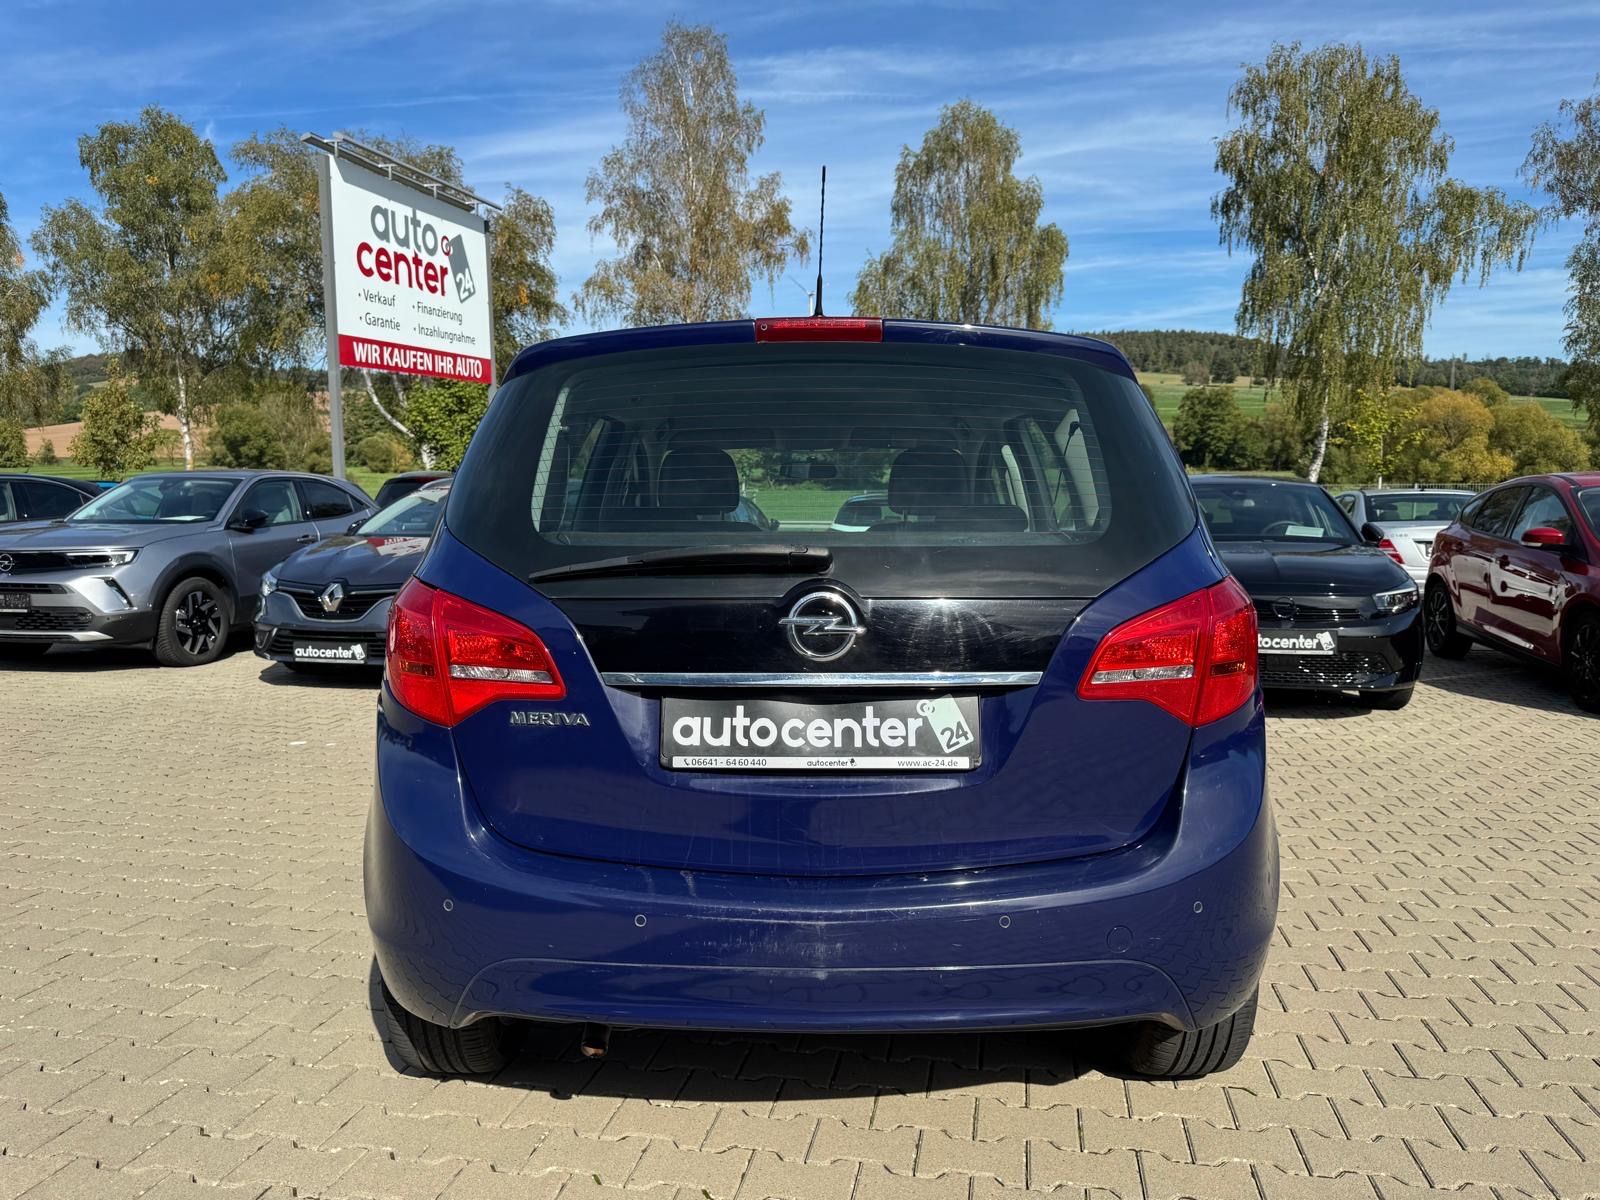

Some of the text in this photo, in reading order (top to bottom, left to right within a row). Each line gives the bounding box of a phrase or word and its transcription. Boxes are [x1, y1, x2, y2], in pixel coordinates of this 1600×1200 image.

[370, 204, 439, 257] auto
[356, 241, 449, 297] center
[456, 267, 475, 301] 24
[363, 288, 396, 308] Verkauf
[365, 312, 401, 331] Garantie
[417, 301, 463, 326] Finanzierung
[418, 323, 476, 345] Inzahlungnahme
[353, 341, 483, 379] WIR KAUFEN IHR AUTO
[294, 645, 353, 658] autocenter
[1257, 633, 1319, 649] tocenter
[510, 711, 591, 727] MERIVA
[672, 705, 924, 748] autocenter
[940, 711, 970, 750] 24
[806, 758, 849, 767] autocenter
[897, 758, 959, 767] www.ac-24.de
